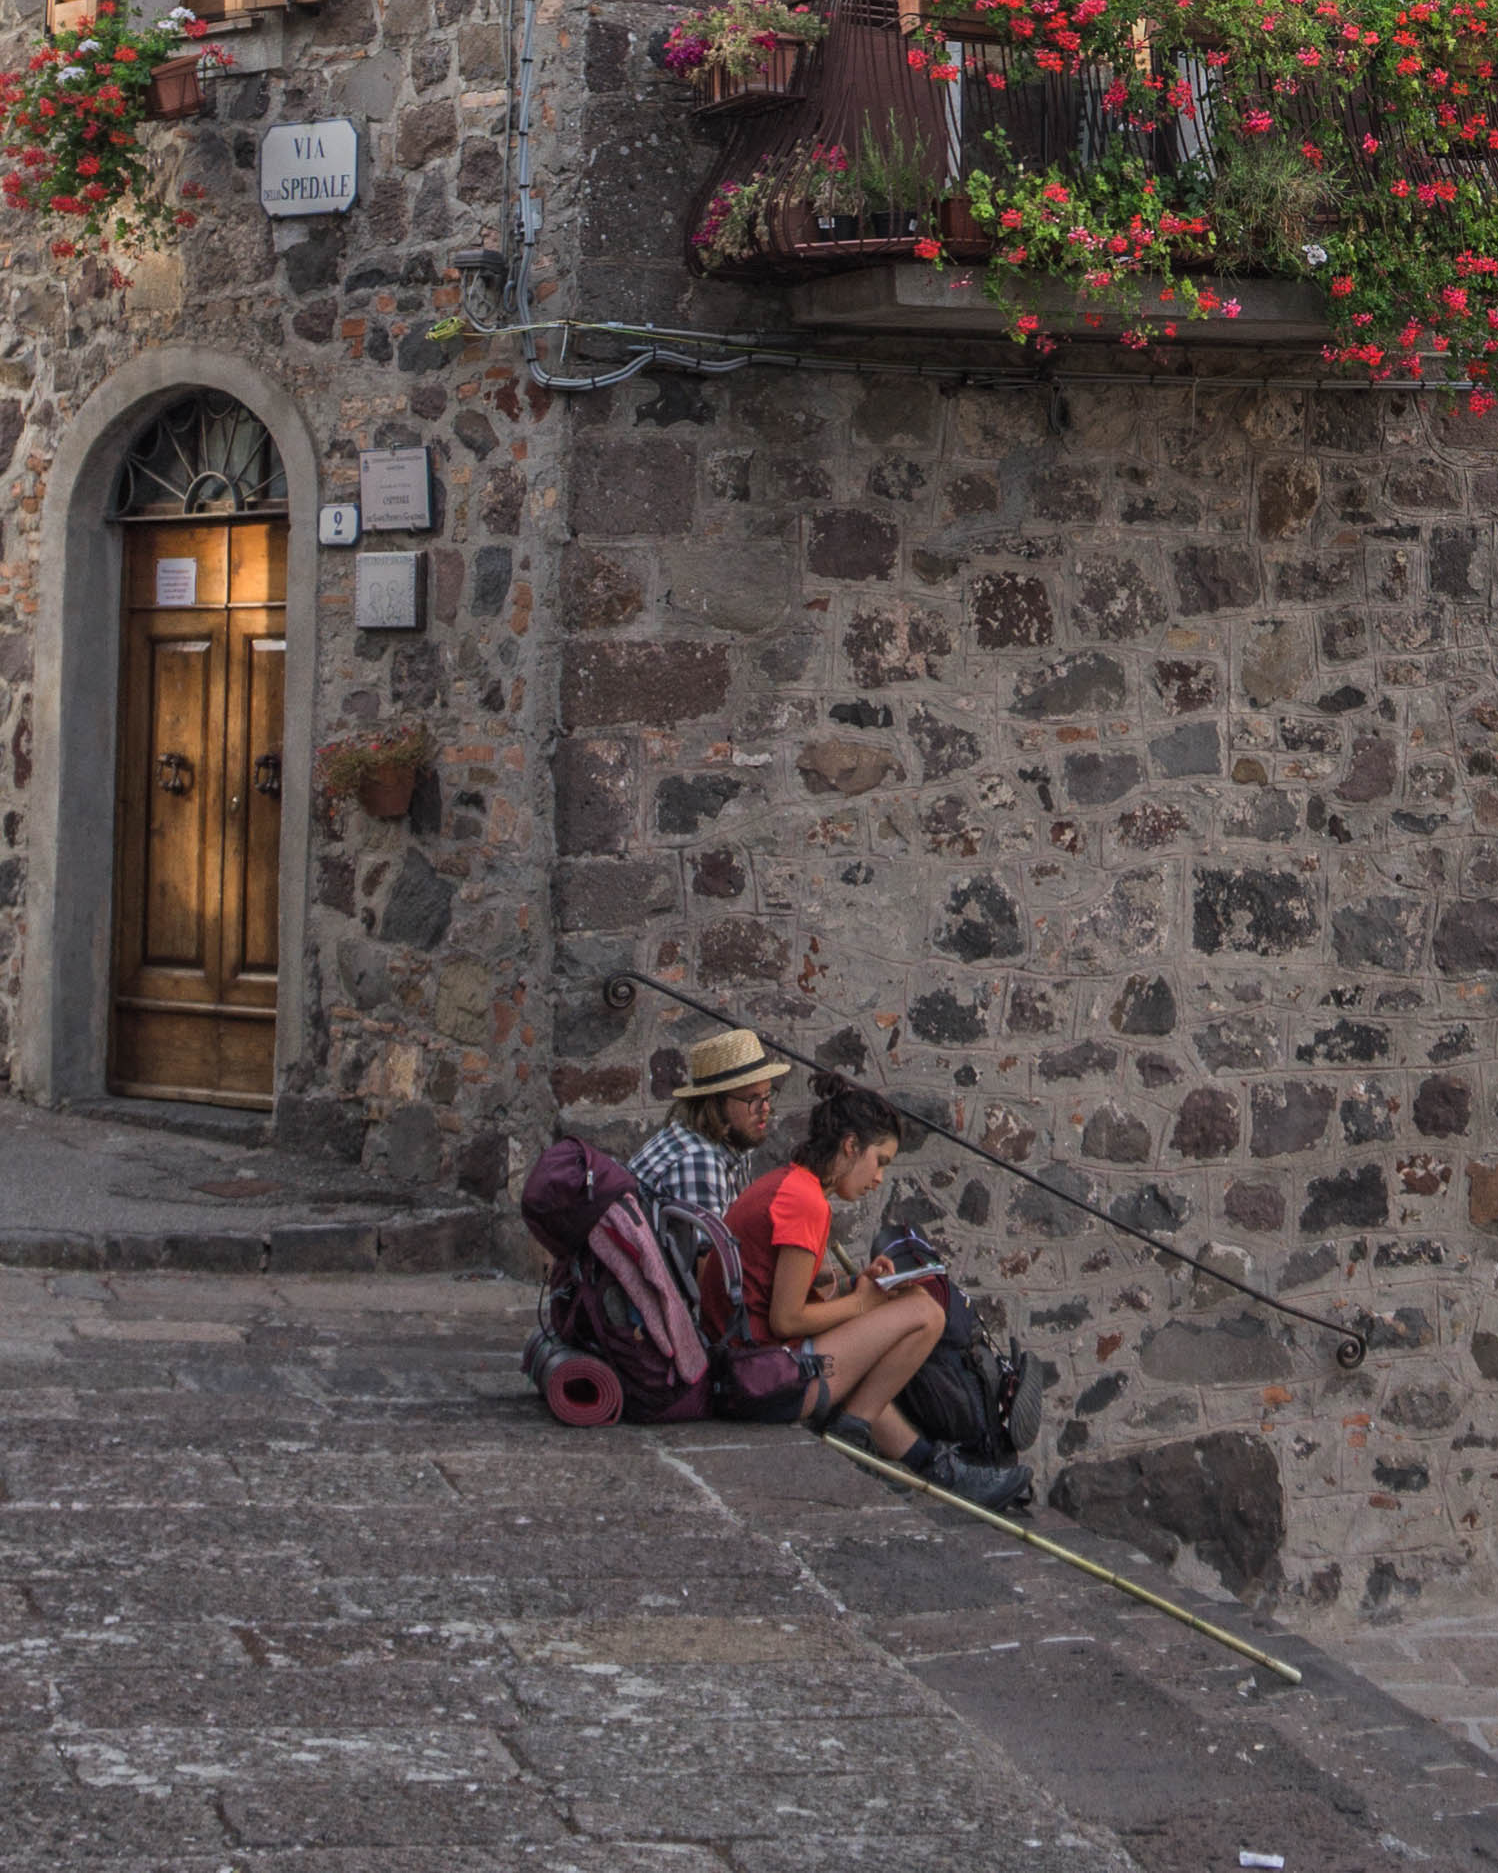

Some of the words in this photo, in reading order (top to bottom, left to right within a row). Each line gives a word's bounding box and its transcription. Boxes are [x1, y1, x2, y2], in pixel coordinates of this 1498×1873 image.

[294, 137, 325, 159] VIA
[281, 175, 350, 200] SPEDALE
[333, 511, 343, 535] 2
